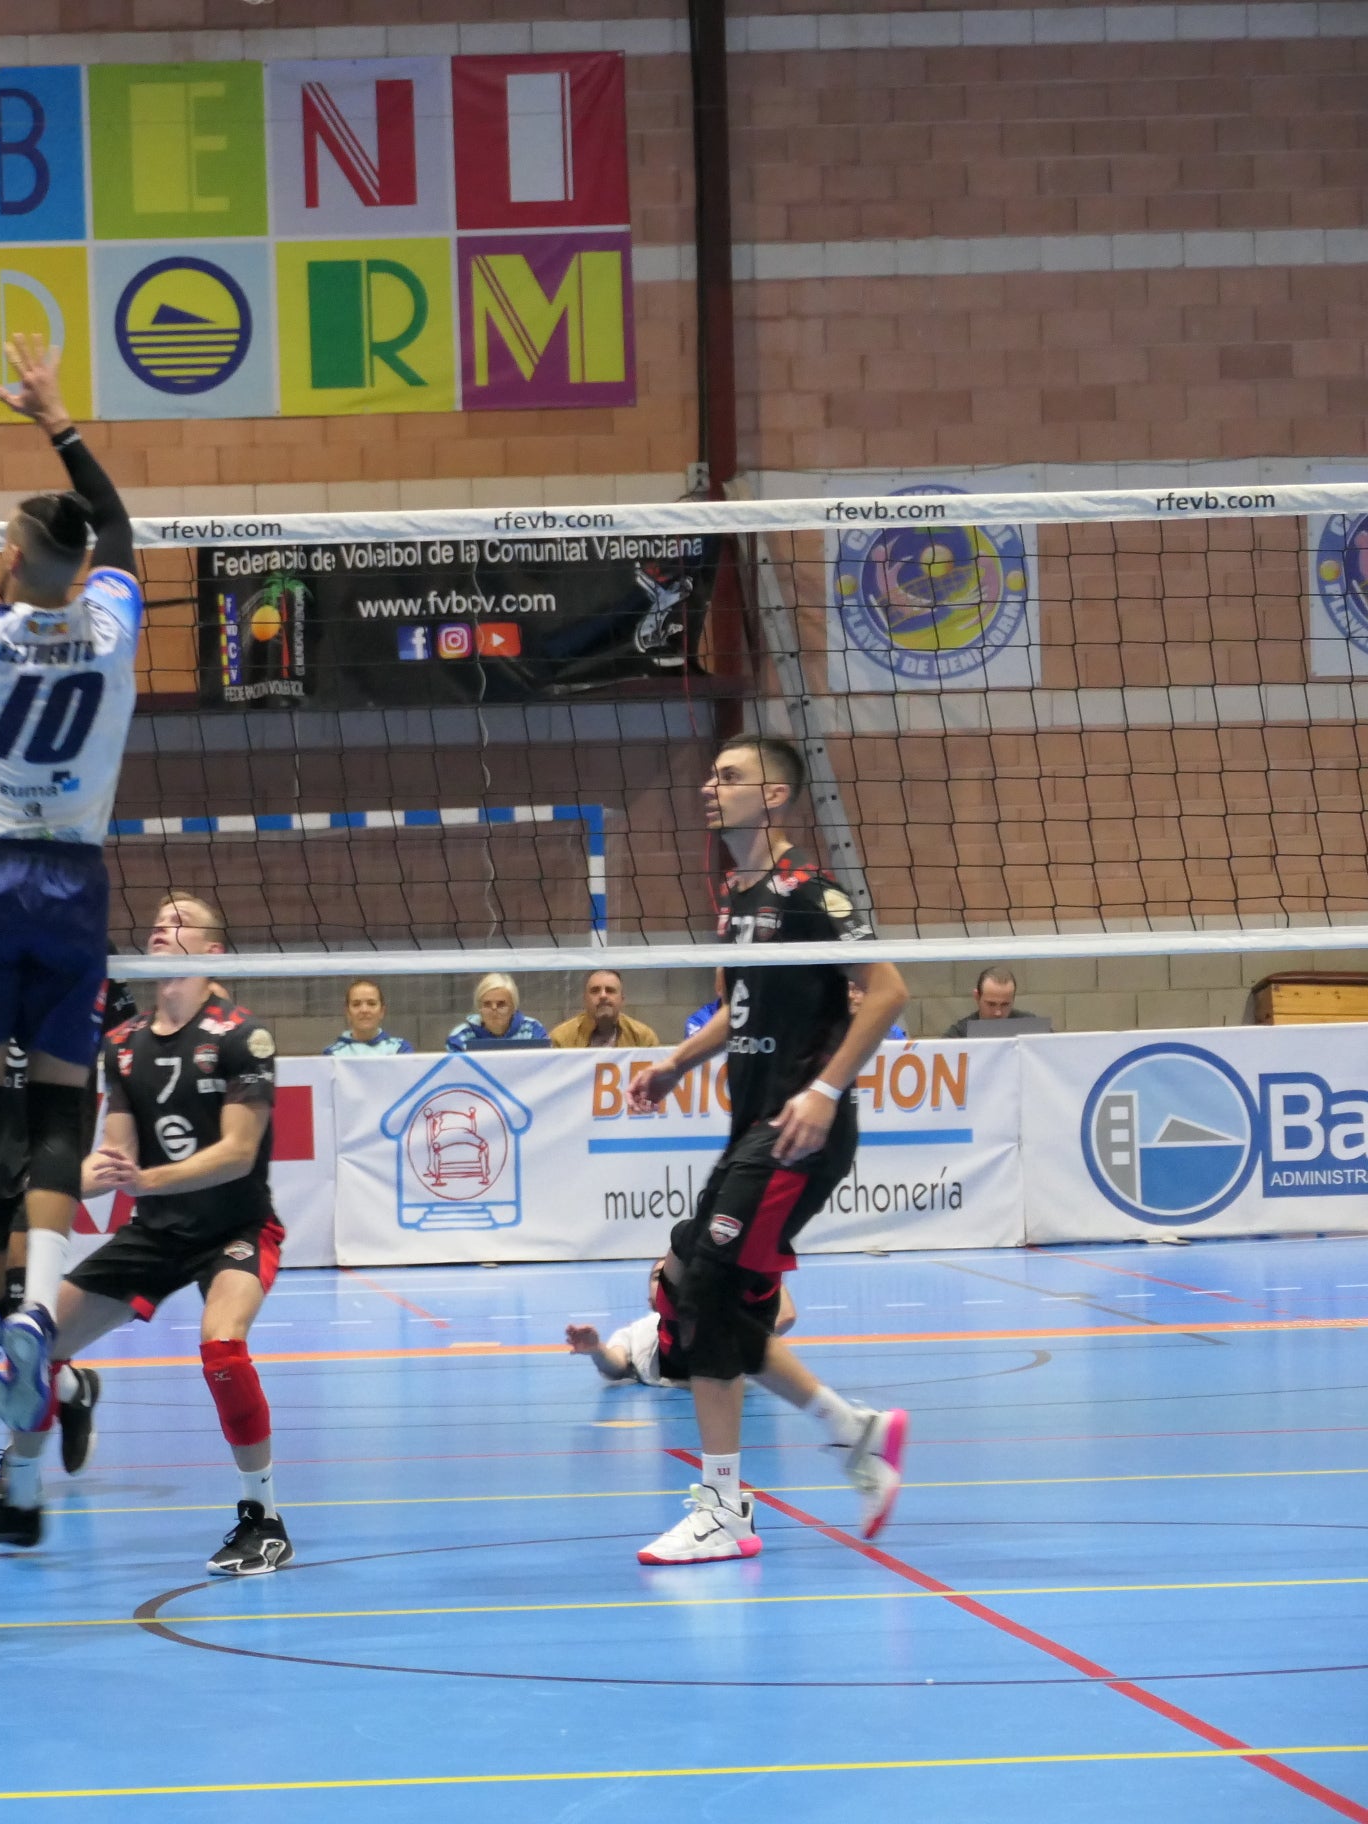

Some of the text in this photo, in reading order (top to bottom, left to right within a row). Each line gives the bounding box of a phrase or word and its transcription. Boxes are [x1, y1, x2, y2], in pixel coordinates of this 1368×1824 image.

[826, 502, 946, 520] rfevb.com
[1156, 493, 1276, 512] rfevb.com
[161, 519, 282, 539] rfevb.com
[494, 511, 615, 531] rfevb.com
[213, 536, 703, 576] Federació de Voleibol de la Comunitat Valenciana
[154, 1056, 182, 1104] 7
[605, 1161, 963, 1221] muebl chonería
